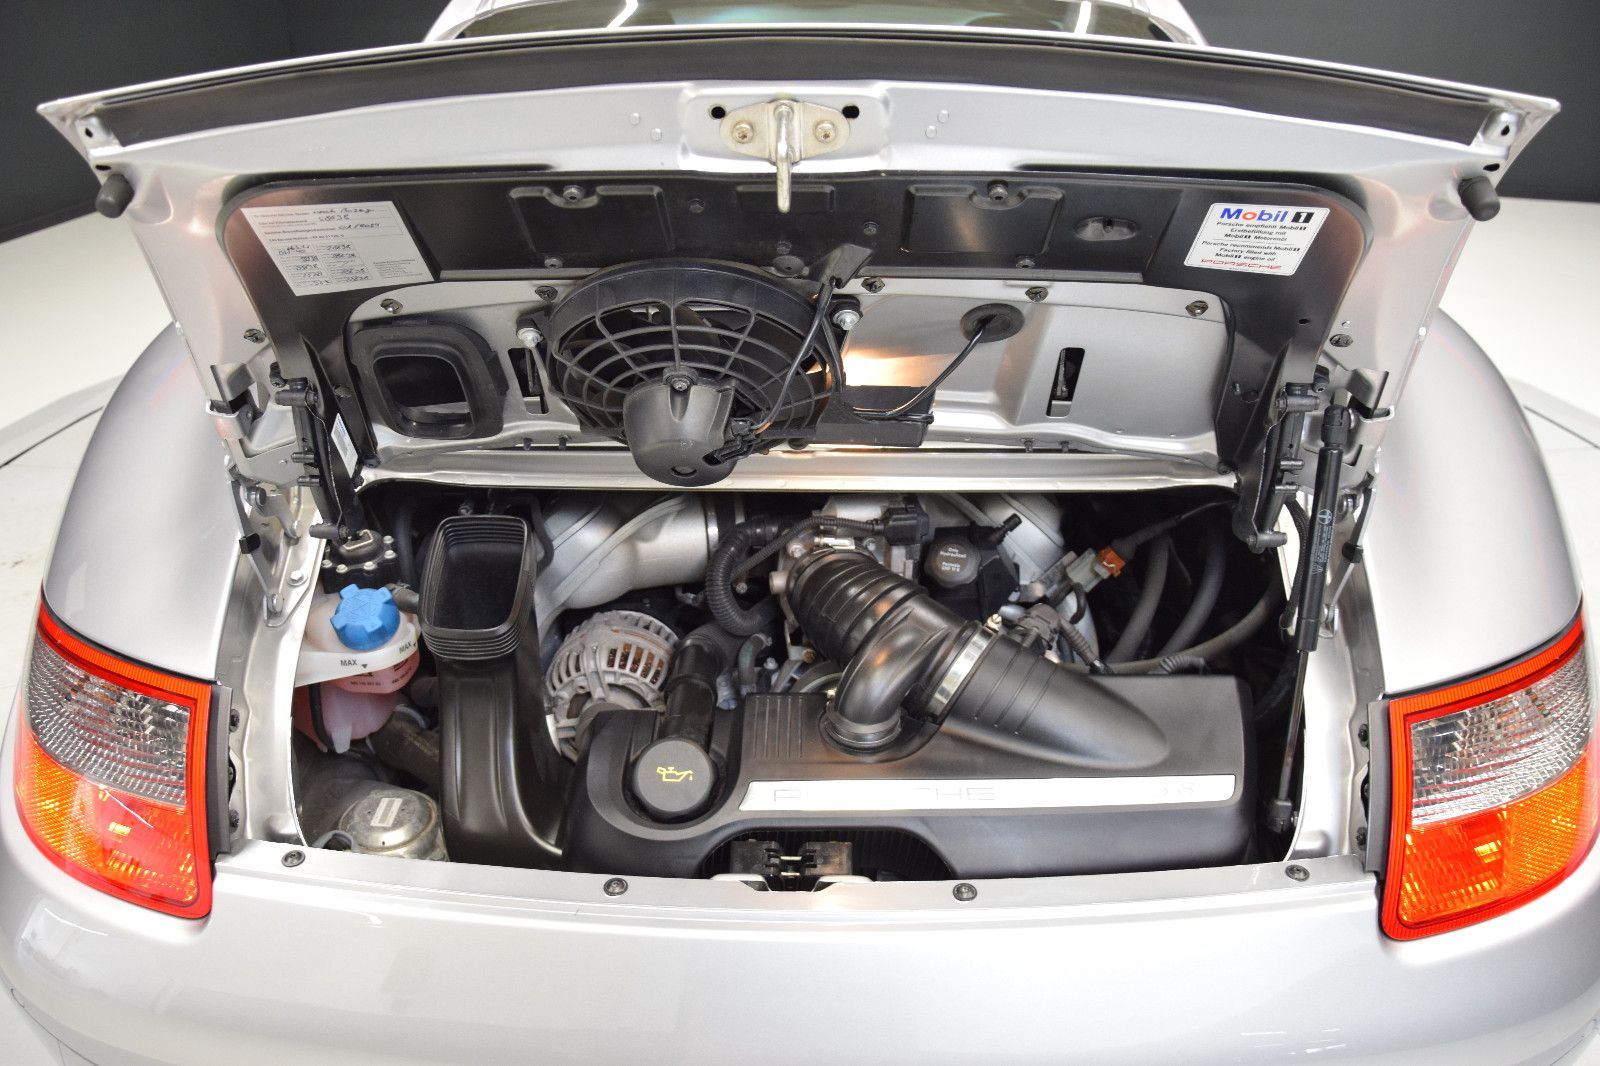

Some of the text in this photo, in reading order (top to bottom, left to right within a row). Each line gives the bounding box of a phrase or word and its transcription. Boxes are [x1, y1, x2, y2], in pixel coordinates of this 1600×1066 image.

[1220, 208, 1288, 222] Mobil
[1200, 259, 1281, 269] PORSCHE
[399, 641, 412, 653] MAX
[340, 659, 358, 667] MAX
